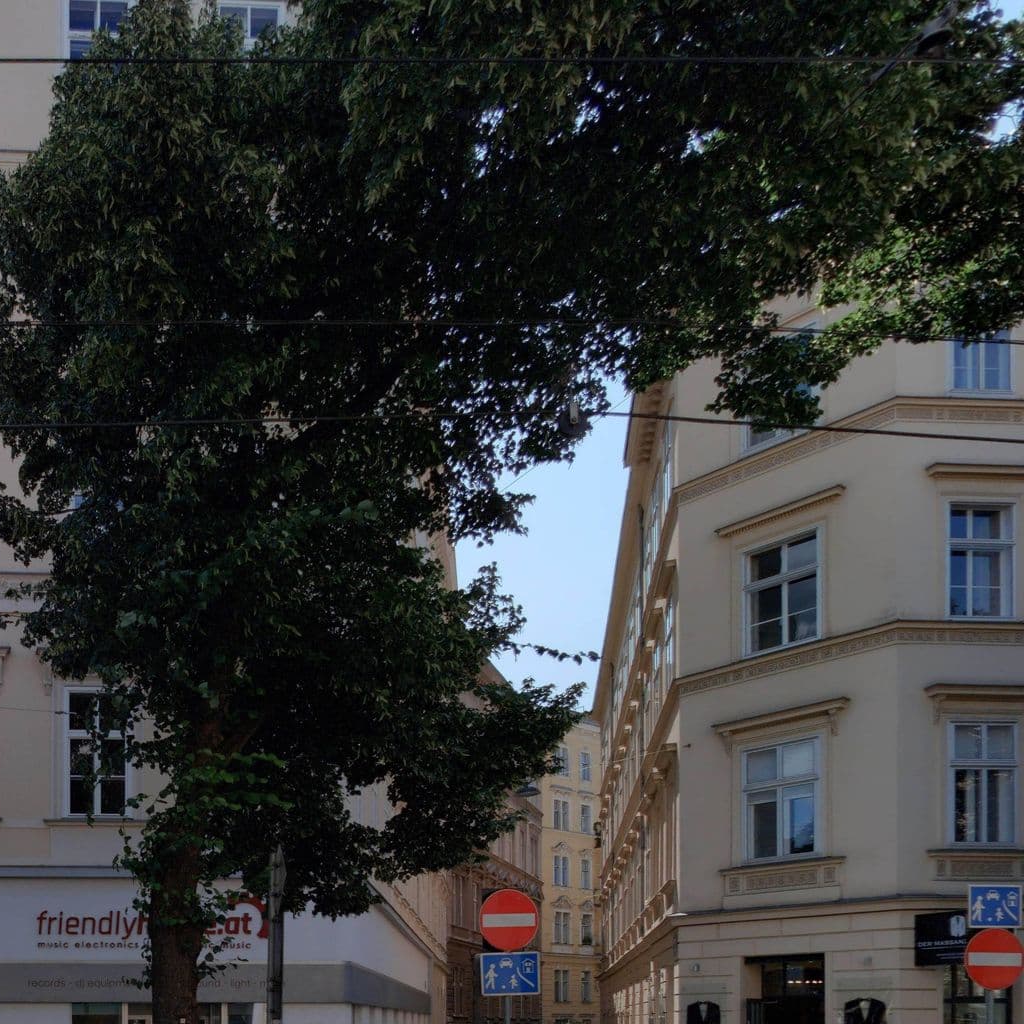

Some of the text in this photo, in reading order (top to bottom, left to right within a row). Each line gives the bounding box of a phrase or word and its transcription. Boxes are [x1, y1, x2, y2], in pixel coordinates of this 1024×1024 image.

[36, 909, 252, 940] friendlyhe.at
[37, 941, 69, 949] music
[74, 941, 140, 949] electronics
